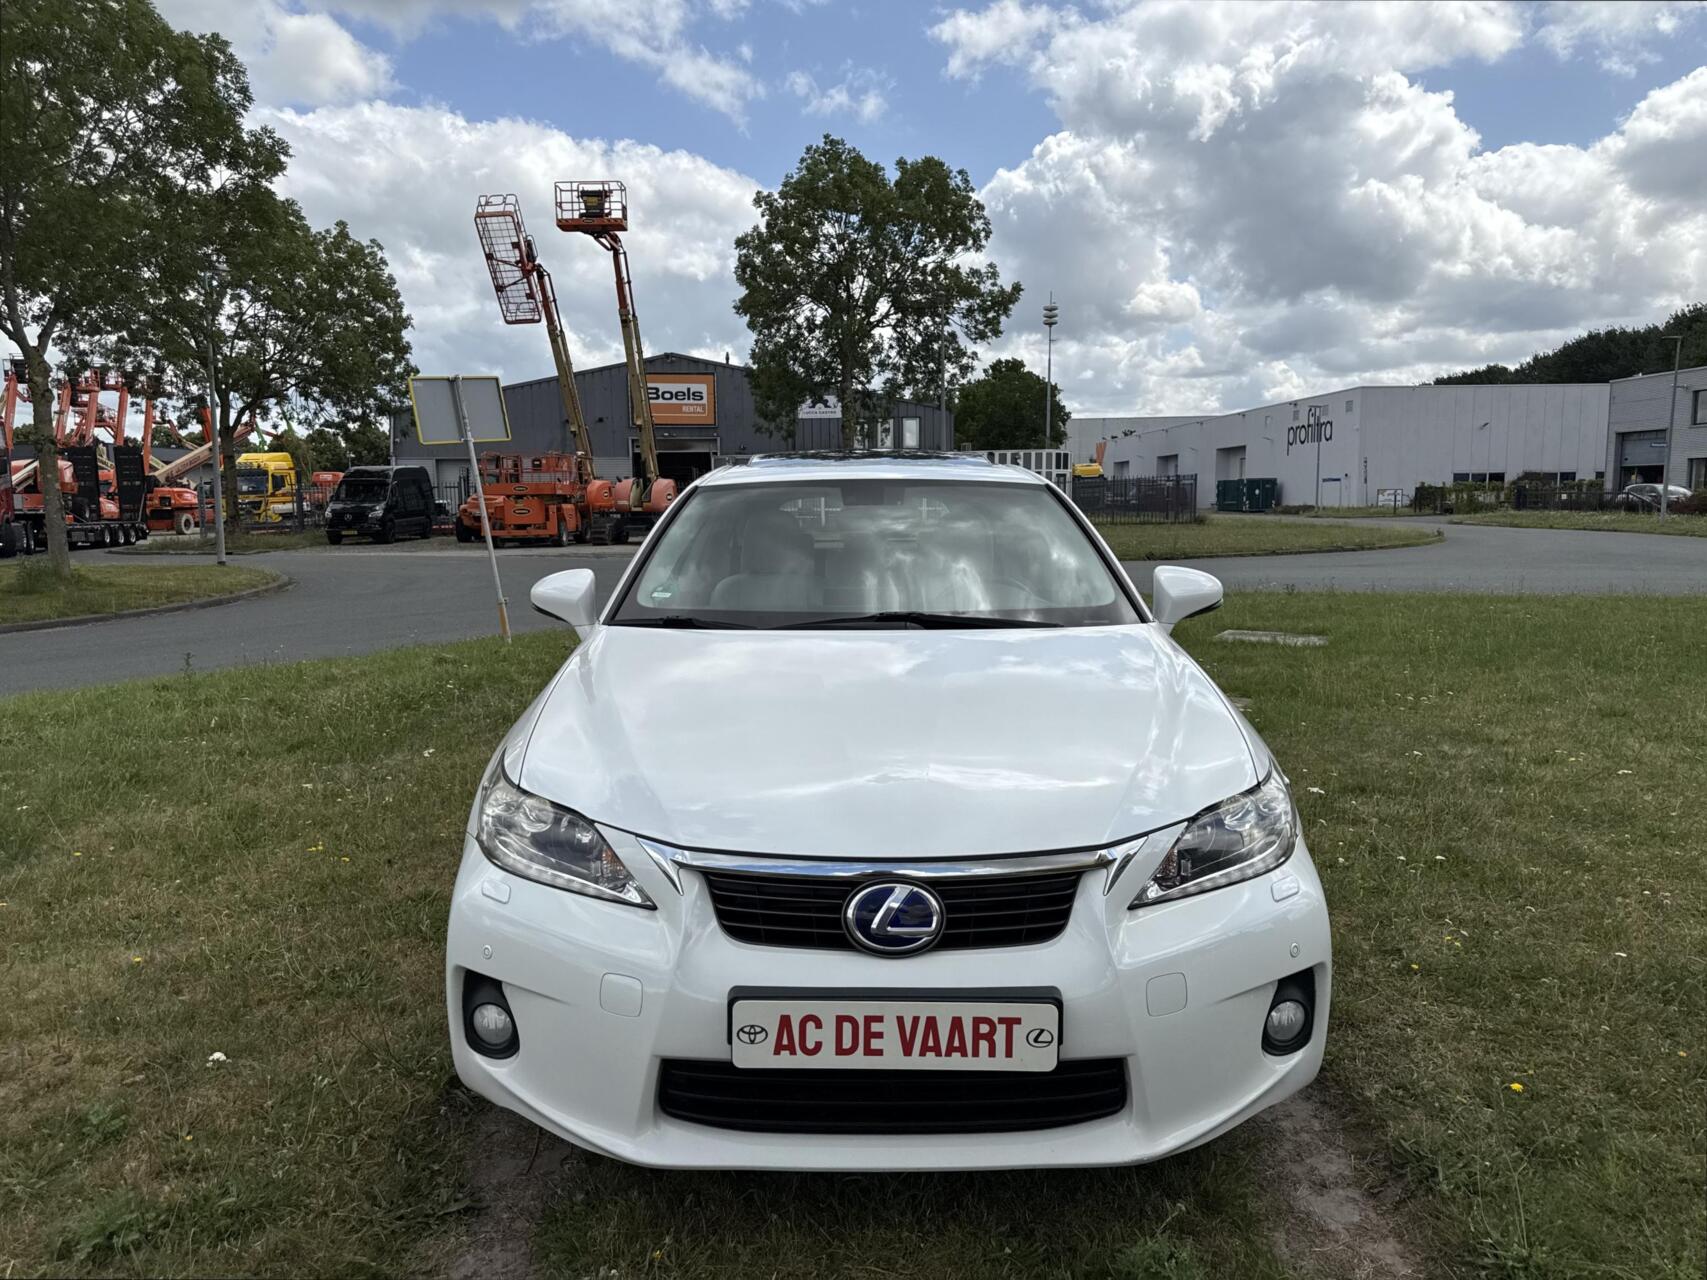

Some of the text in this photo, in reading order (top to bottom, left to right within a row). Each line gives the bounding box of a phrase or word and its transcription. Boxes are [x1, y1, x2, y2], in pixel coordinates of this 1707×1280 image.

[647, 387, 704, 401] Boels
[682, 404, 704, 413] RENTAL
[1286, 408, 1333, 456] profiltra
[773, 1014, 823, 1056] AC
[834, 1015, 884, 1056] DE
[896, 1016, 1021, 1058] VAART
